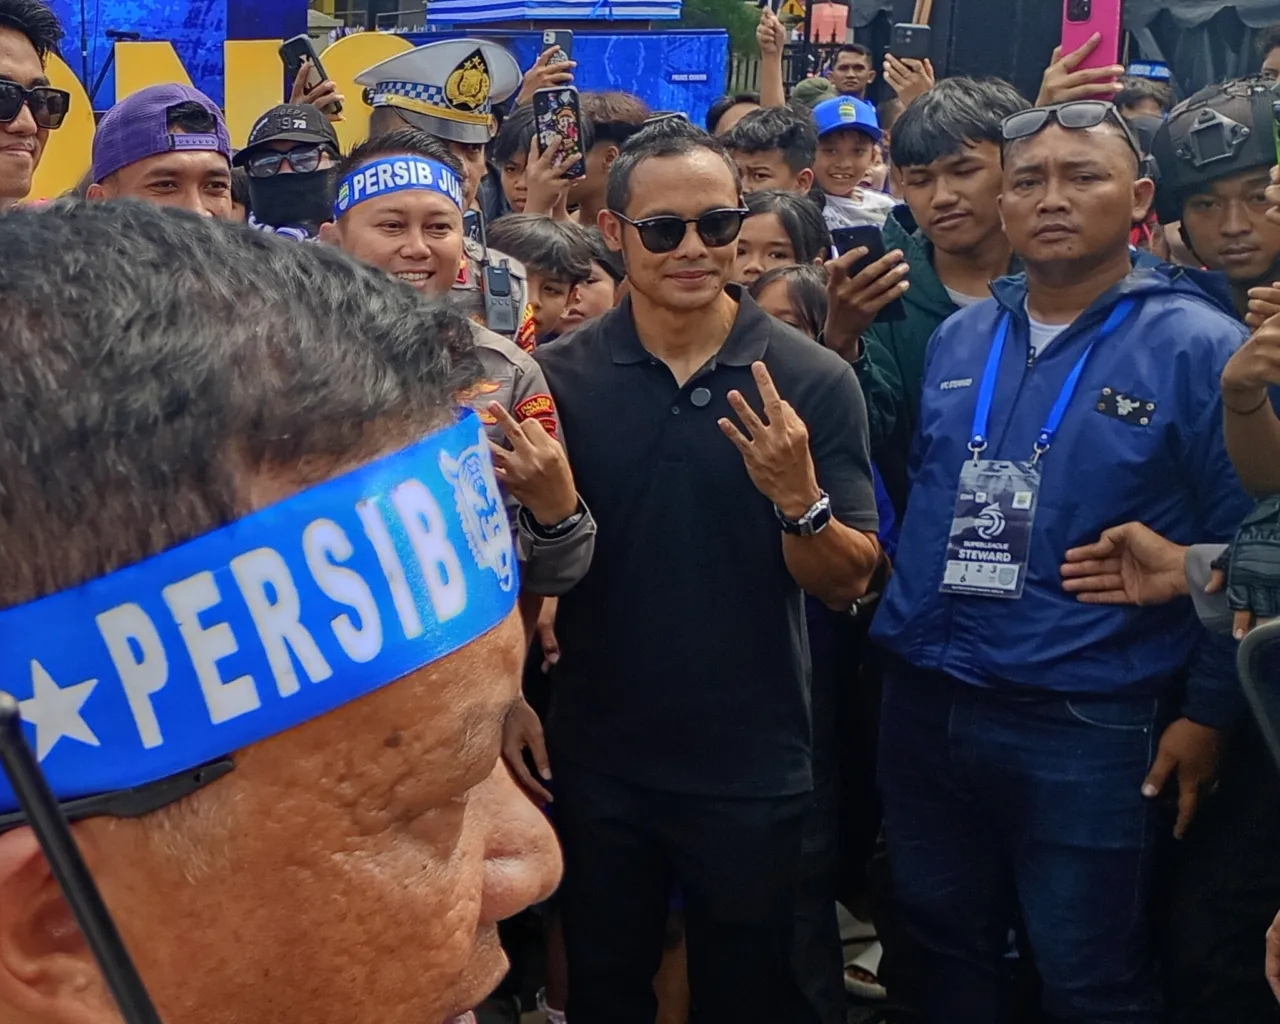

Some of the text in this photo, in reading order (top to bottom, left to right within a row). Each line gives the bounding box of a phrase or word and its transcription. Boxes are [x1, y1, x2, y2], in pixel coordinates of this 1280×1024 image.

[353, 161, 433, 200] PERSIB
[958, 549, 1012, 562] STEWARD
[95, 478, 467, 749] PERSIB
